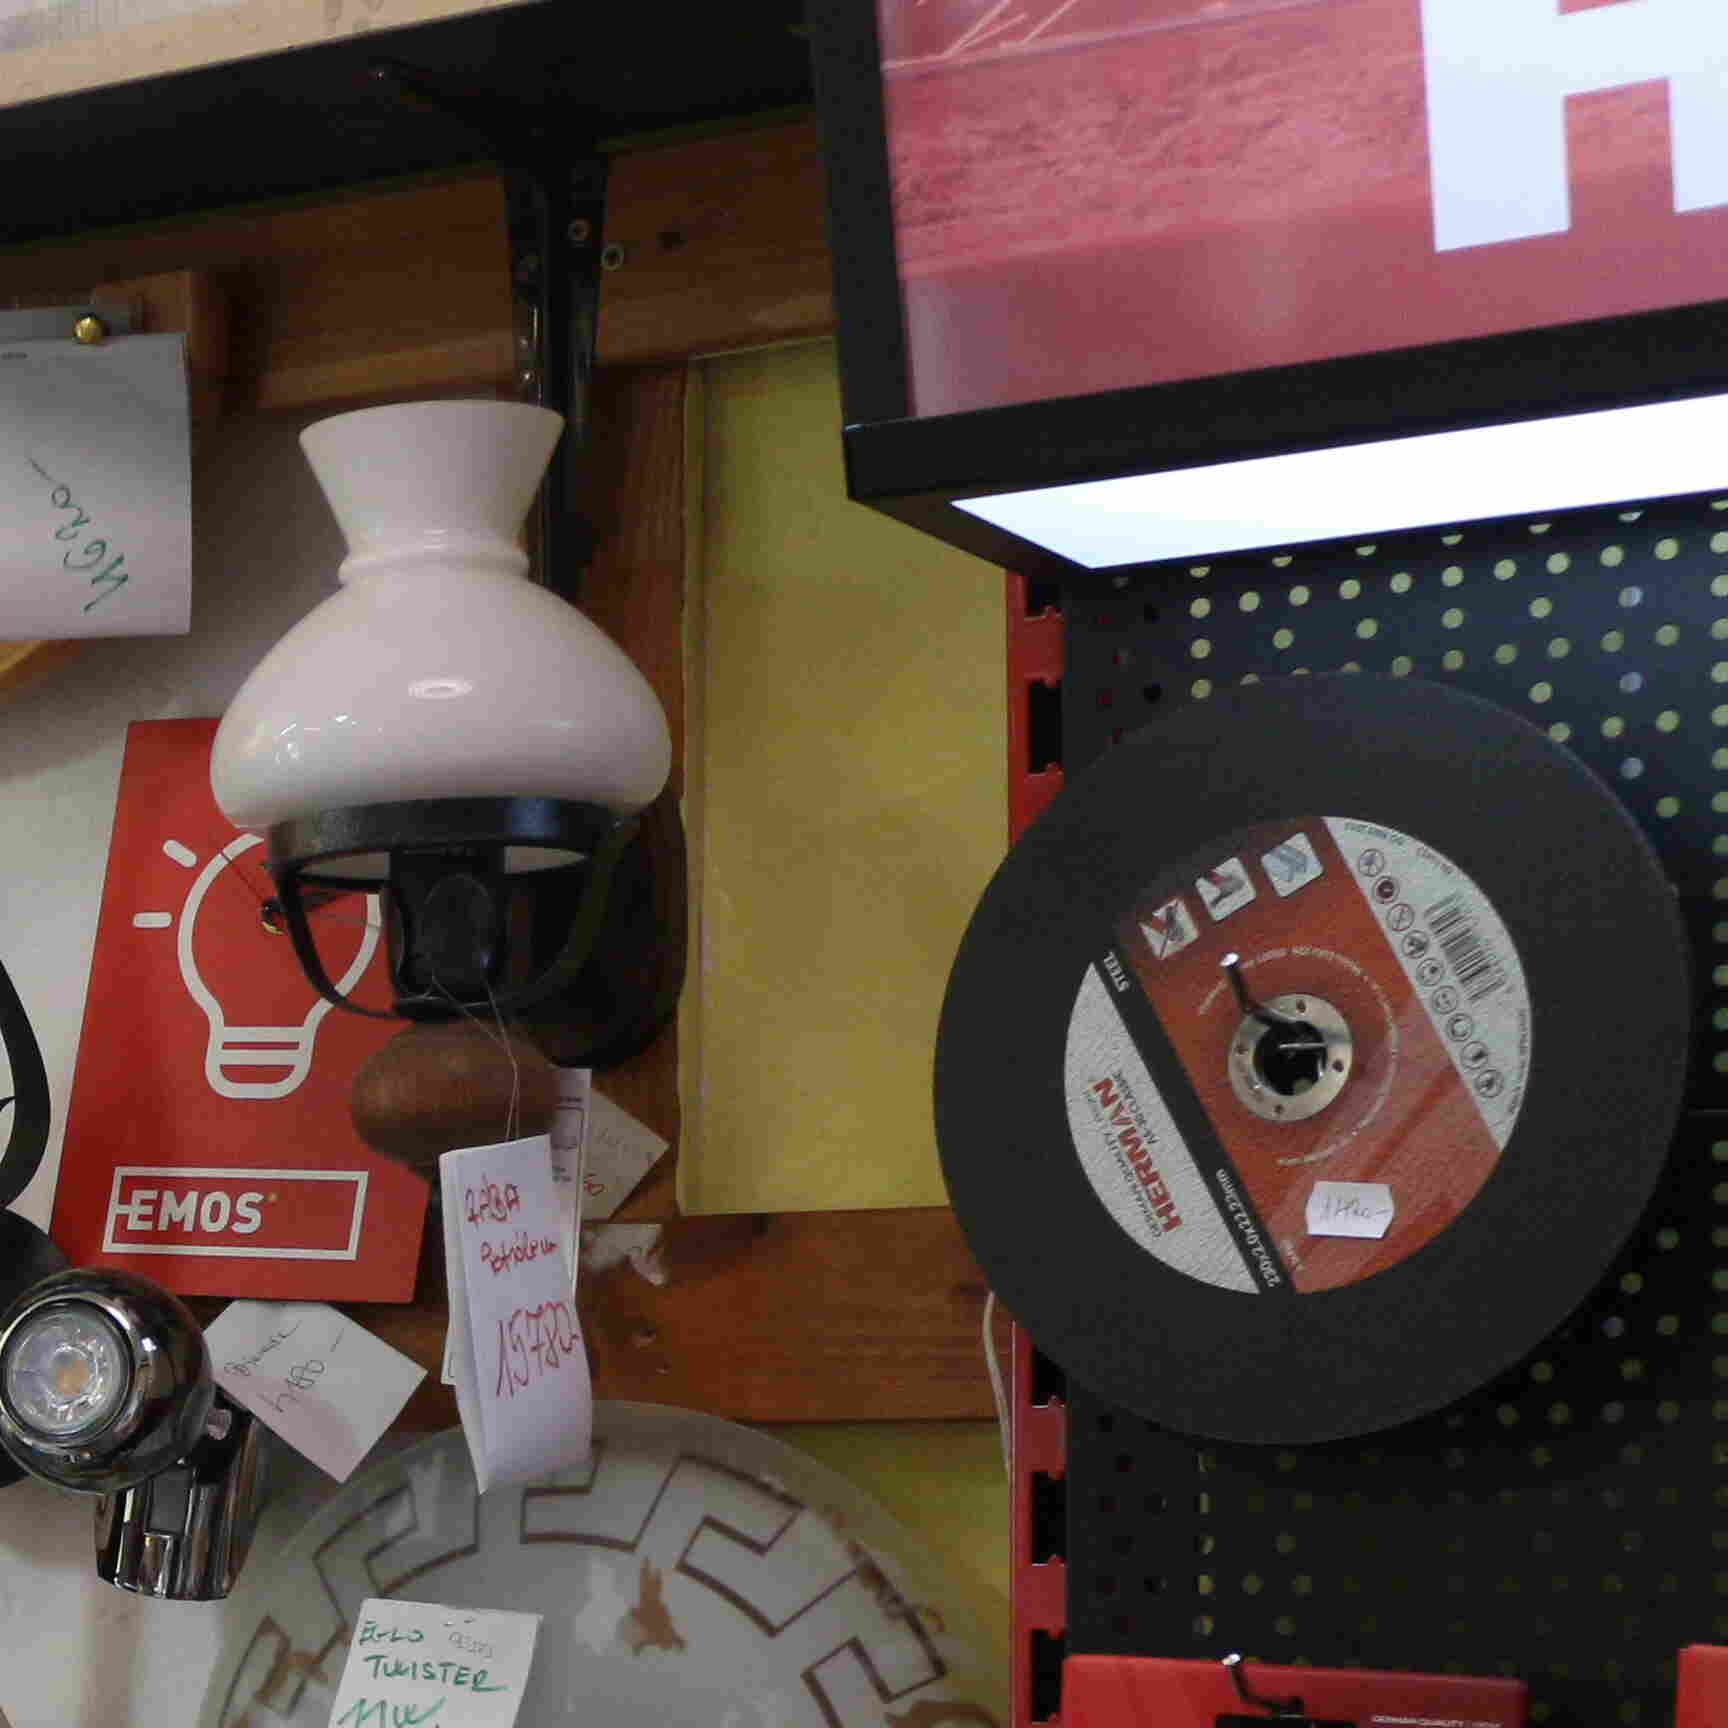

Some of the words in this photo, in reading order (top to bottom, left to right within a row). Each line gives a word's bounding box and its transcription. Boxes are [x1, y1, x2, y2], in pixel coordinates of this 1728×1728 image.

[1092, 1077, 1184, 1234] HERMAN
[127, 1190, 264, 1234] EMOS
[364, 1656, 508, 1693] TWISTER
